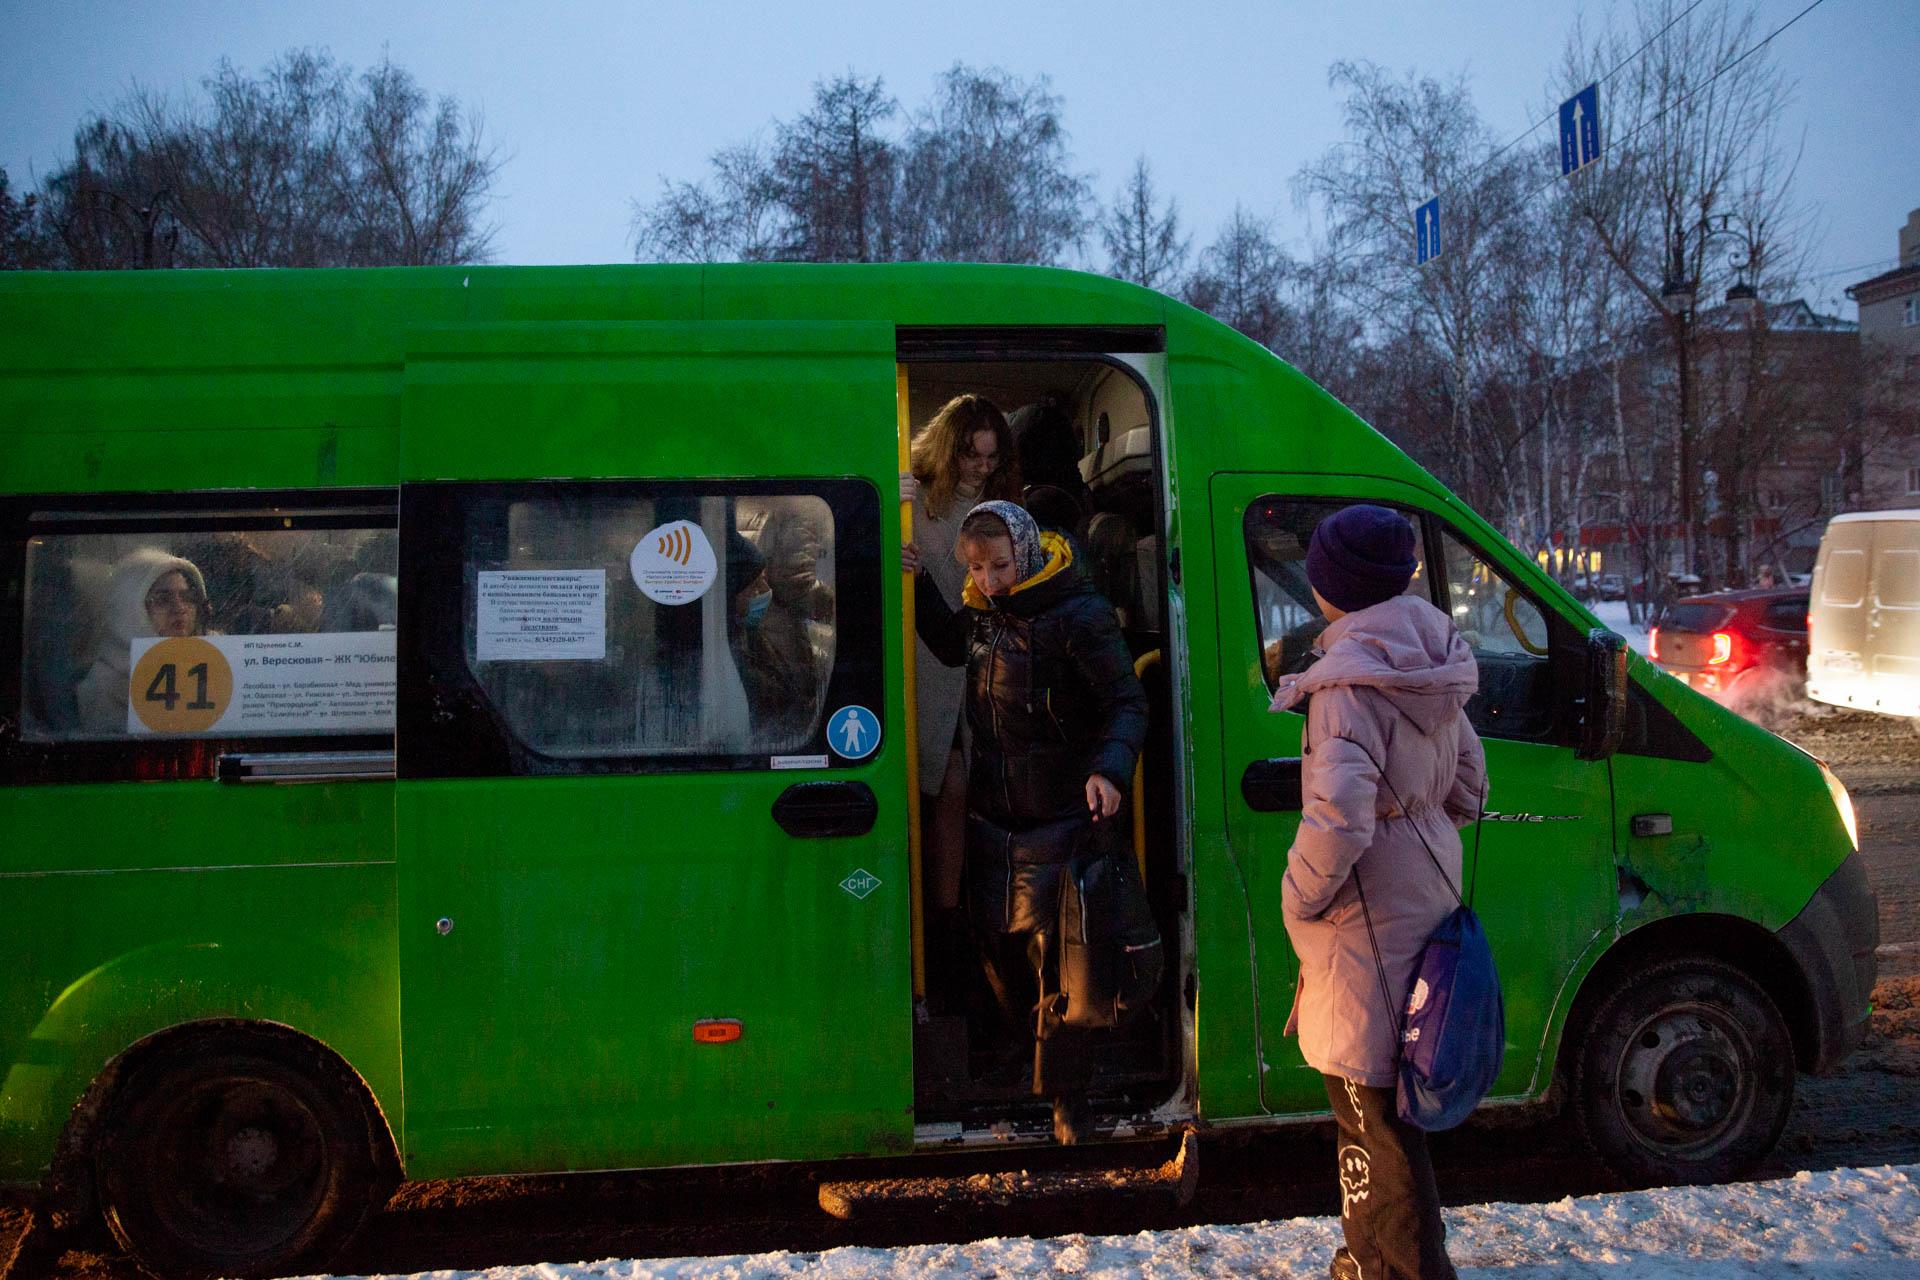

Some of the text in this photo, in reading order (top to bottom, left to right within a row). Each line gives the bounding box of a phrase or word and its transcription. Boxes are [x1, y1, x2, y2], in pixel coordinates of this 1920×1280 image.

[244, 657, 259, 668] ул.
[262, 656, 323, 667] Вересковая
[334, 655, 352, 664] ЖК
[146, 662, 216, 711] 41
[848, 877, 873, 890] СНГ
